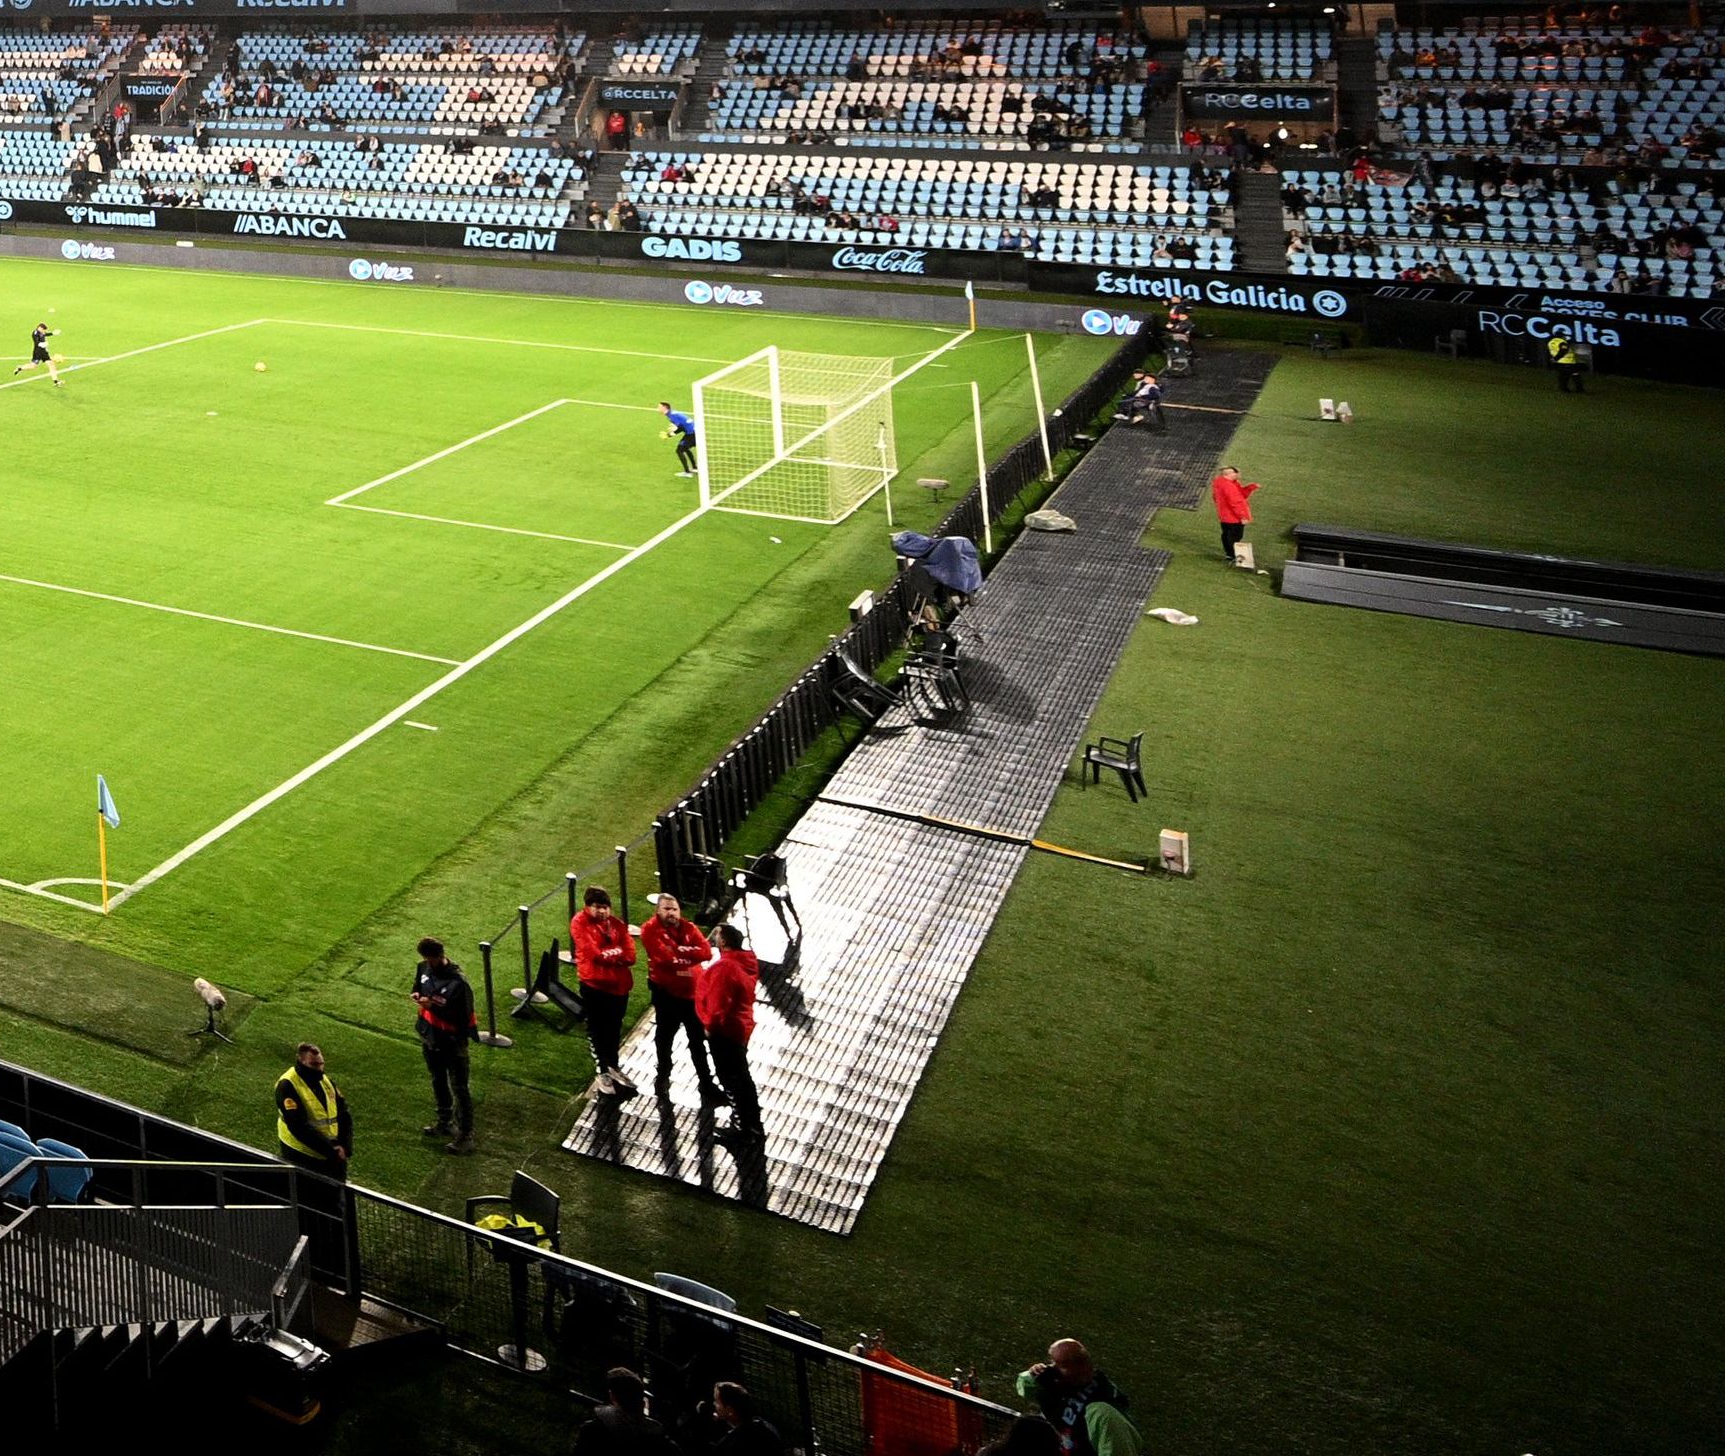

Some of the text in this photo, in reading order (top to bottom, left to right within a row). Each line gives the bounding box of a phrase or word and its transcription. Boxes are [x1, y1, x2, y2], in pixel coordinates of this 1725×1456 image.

[604, 88, 678, 101] @RCCELTA
[87, 209, 156, 228] hummel
[245, 214, 346, 239] ABANCA
[464, 227, 557, 252] Recalvi
[641, 237, 742, 262] GADIS
[832, 246, 929, 275] Coca-Cola
[1095, 271, 1306, 312] Estrella Galicia
[1540, 295, 1605, 310] Acceso
